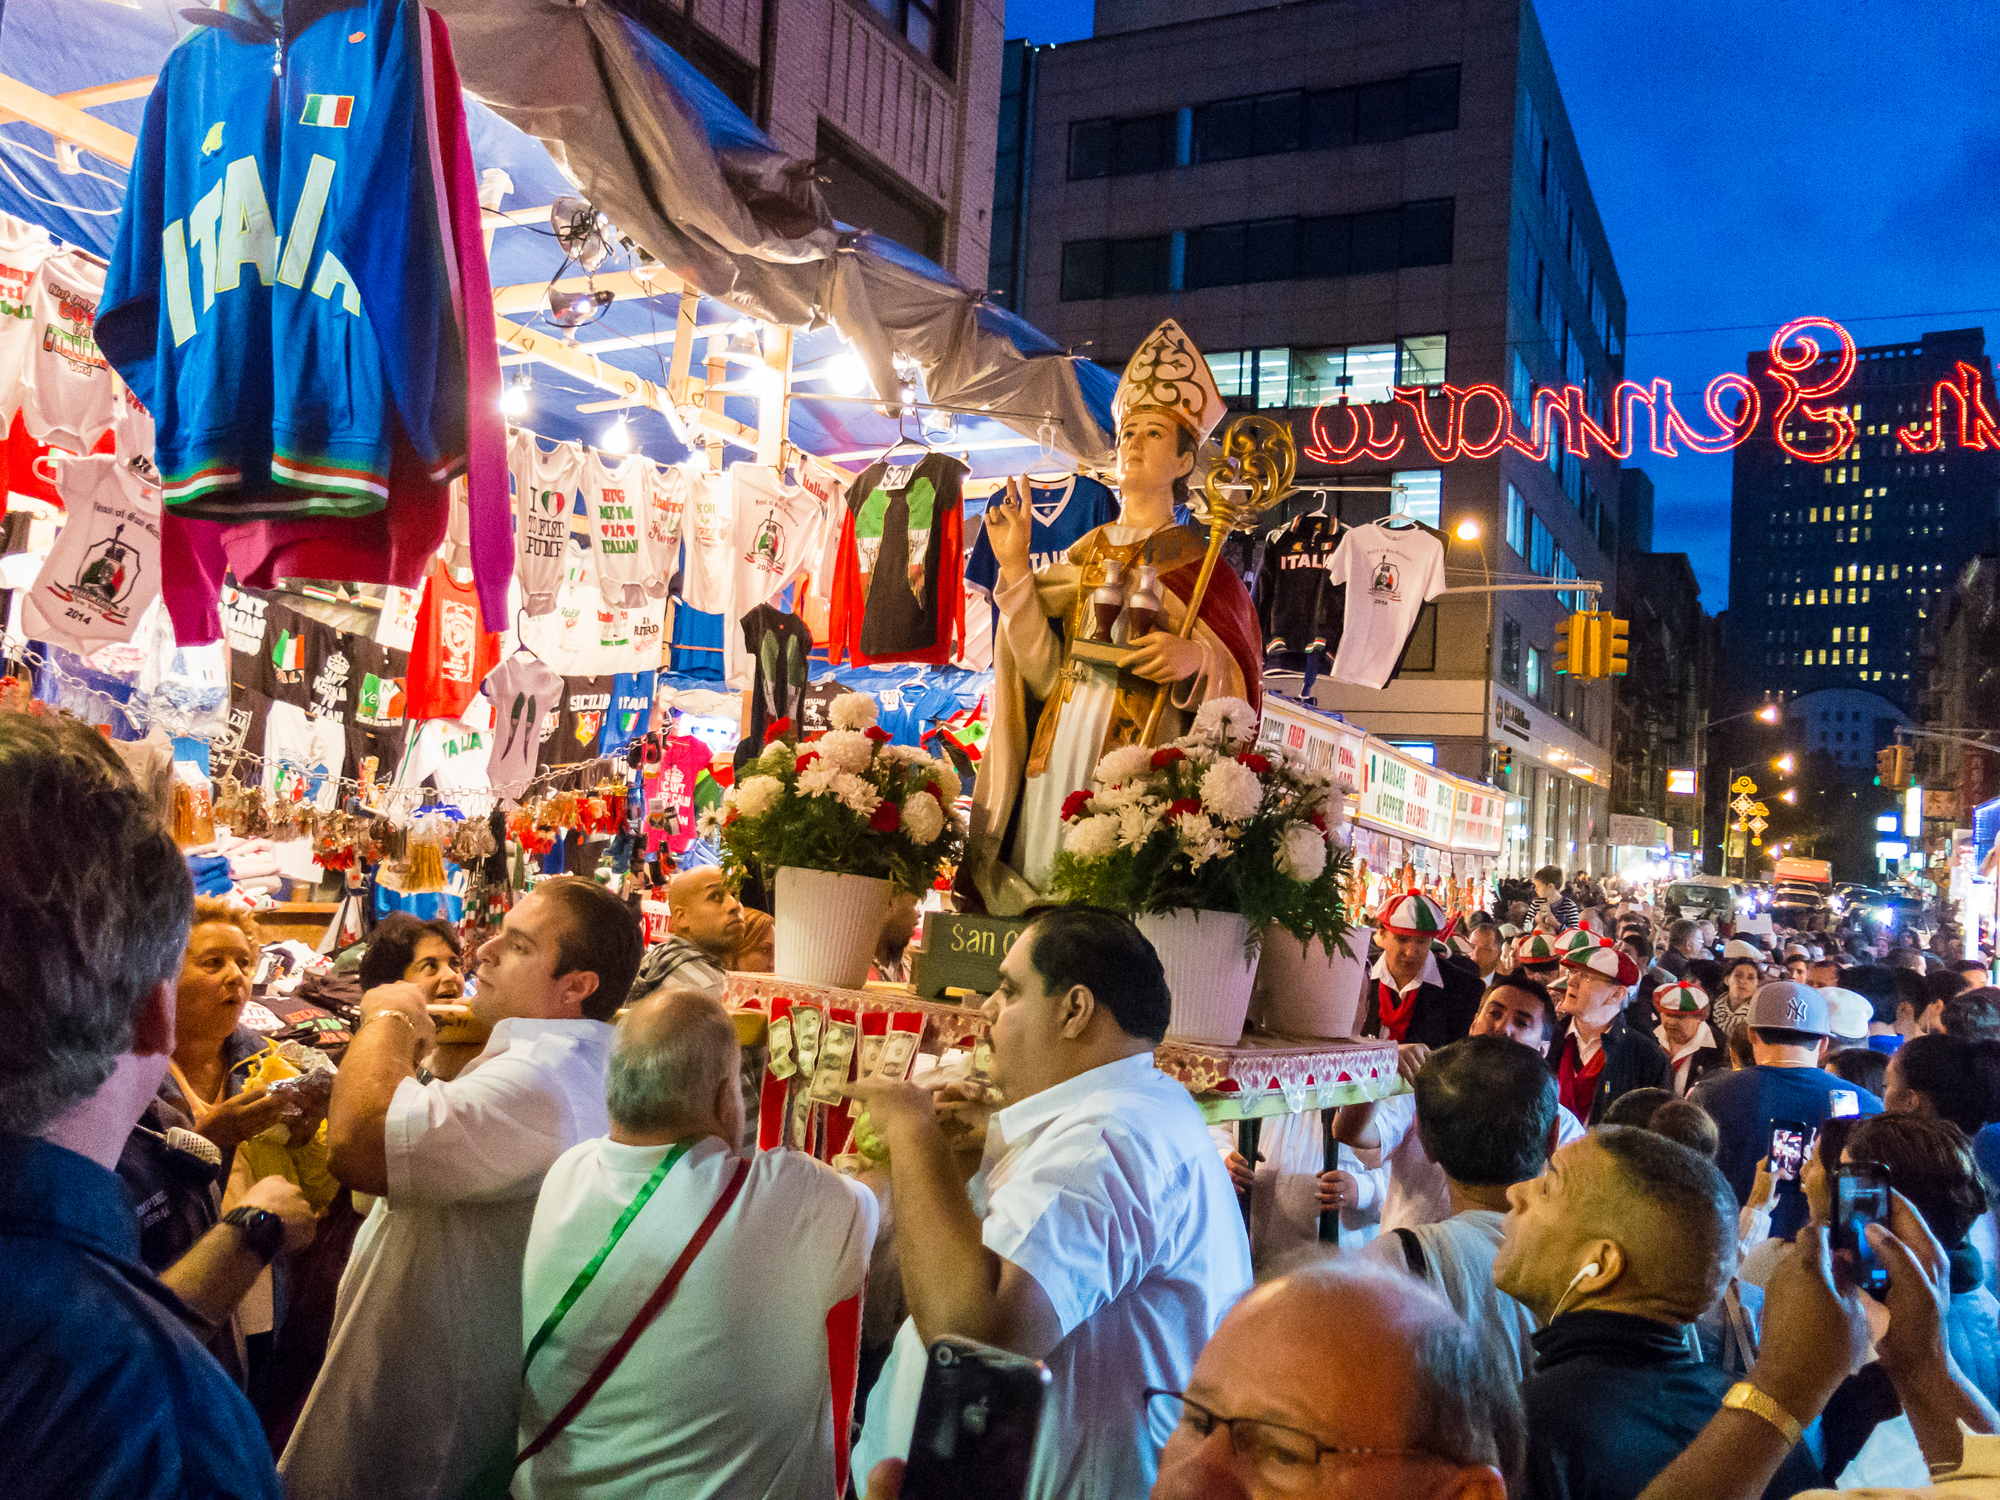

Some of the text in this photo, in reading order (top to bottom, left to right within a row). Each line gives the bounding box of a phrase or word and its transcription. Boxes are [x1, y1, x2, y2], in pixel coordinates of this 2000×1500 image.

[529, 486, 538, 513] I
[601, 488, 626, 503] HUG
[802, 473, 829, 503] Italian
[599, 505, 615, 520] ME
[538, 518, 564, 538] FIST
[601, 539, 638, 554] ITALIAN
[65, 607, 92, 625] 2014
[882, 690, 896, 705] $20
[1383, 754, 1407, 791] SAUSAGE
[1413, 773, 1428, 799] PORK
[951, 923, 995, 956] San
[1787, 996, 1808, 1022] NY
